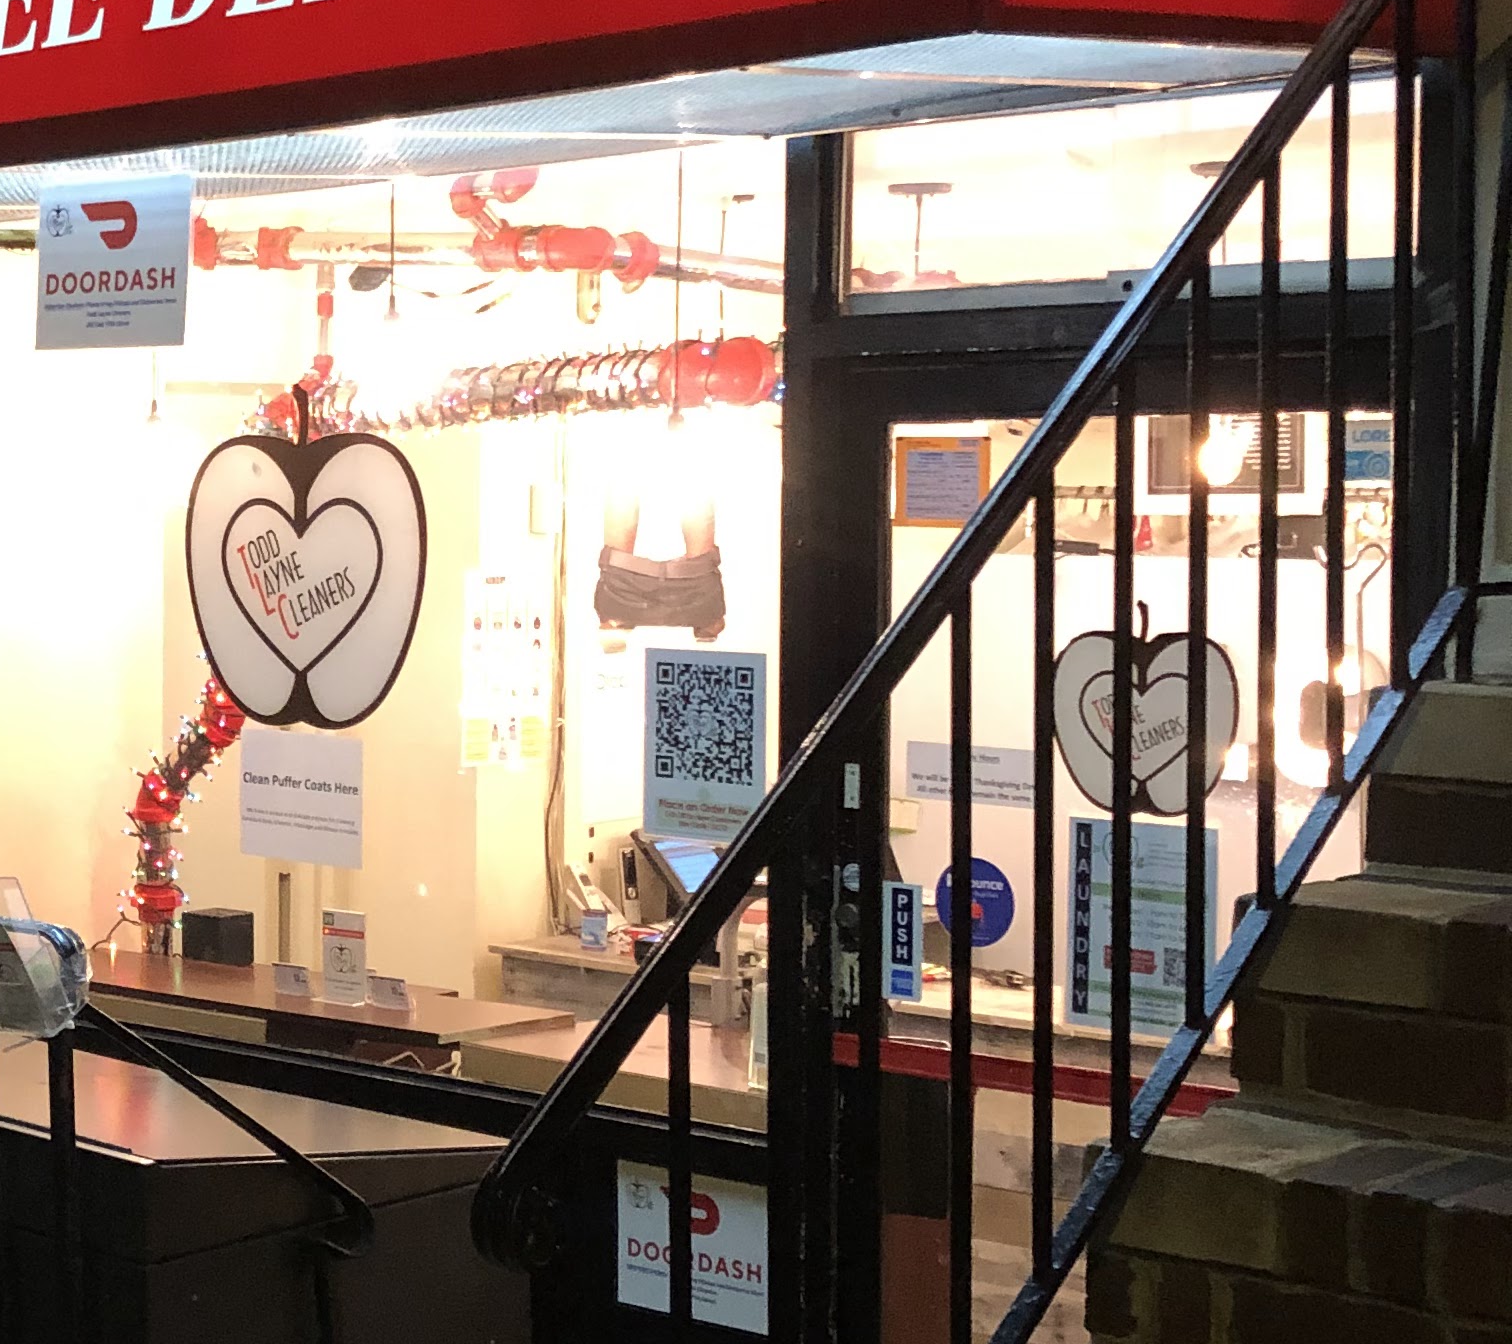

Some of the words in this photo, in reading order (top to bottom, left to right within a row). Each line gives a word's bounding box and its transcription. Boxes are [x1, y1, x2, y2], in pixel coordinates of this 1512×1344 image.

[45, 266, 176, 295] DOORDASH
[237, 529, 280, 589] TODD
[253, 550, 305, 616] LAYNE
[277, 565, 356, 640] CLEANERS
[1131, 716, 1185, 760] LEANERS
[242, 771, 270, 785] Clean
[272, 774, 302, 789] Puffer
[304, 778, 332, 793] Coats
[334, 782, 359, 796] Here
[896, 894, 909, 959] PUSH
[1075, 831, 1089, 1006] LAUNDRY
[627, 1237, 762, 1285] DOODASH
